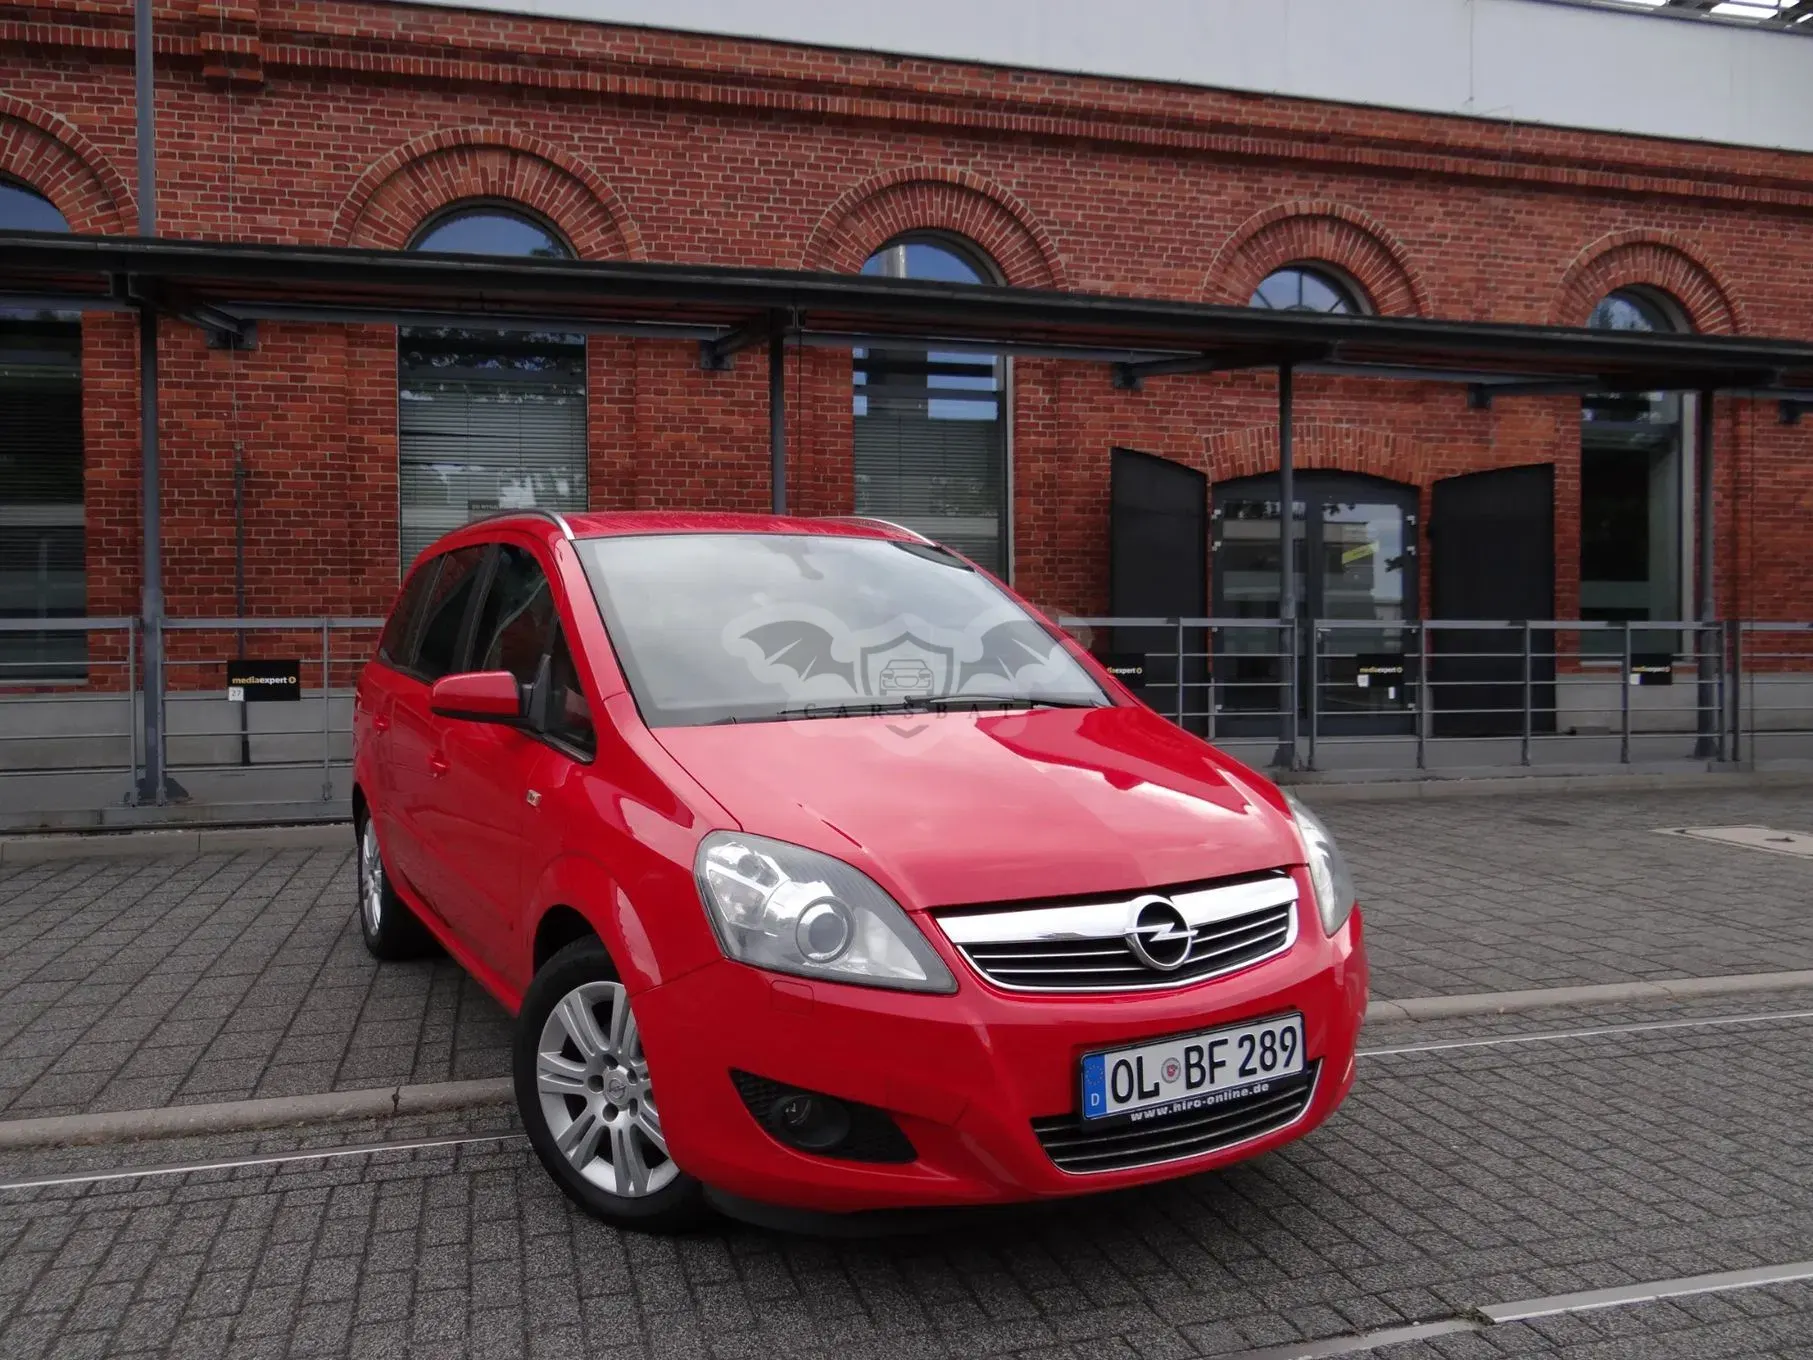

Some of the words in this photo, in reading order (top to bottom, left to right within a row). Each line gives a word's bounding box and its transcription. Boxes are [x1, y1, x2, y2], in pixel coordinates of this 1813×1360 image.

[232, 676, 287, 685] mediaexpert
[1111, 1056, 1160, 1104] OL
[1184, 1038, 1229, 1090] BF
[1238, 1025, 1297, 1078] 289
[1091, 1093, 1100, 1106] D
[1130, 1083, 1270, 1122] www.hiro-online.de
